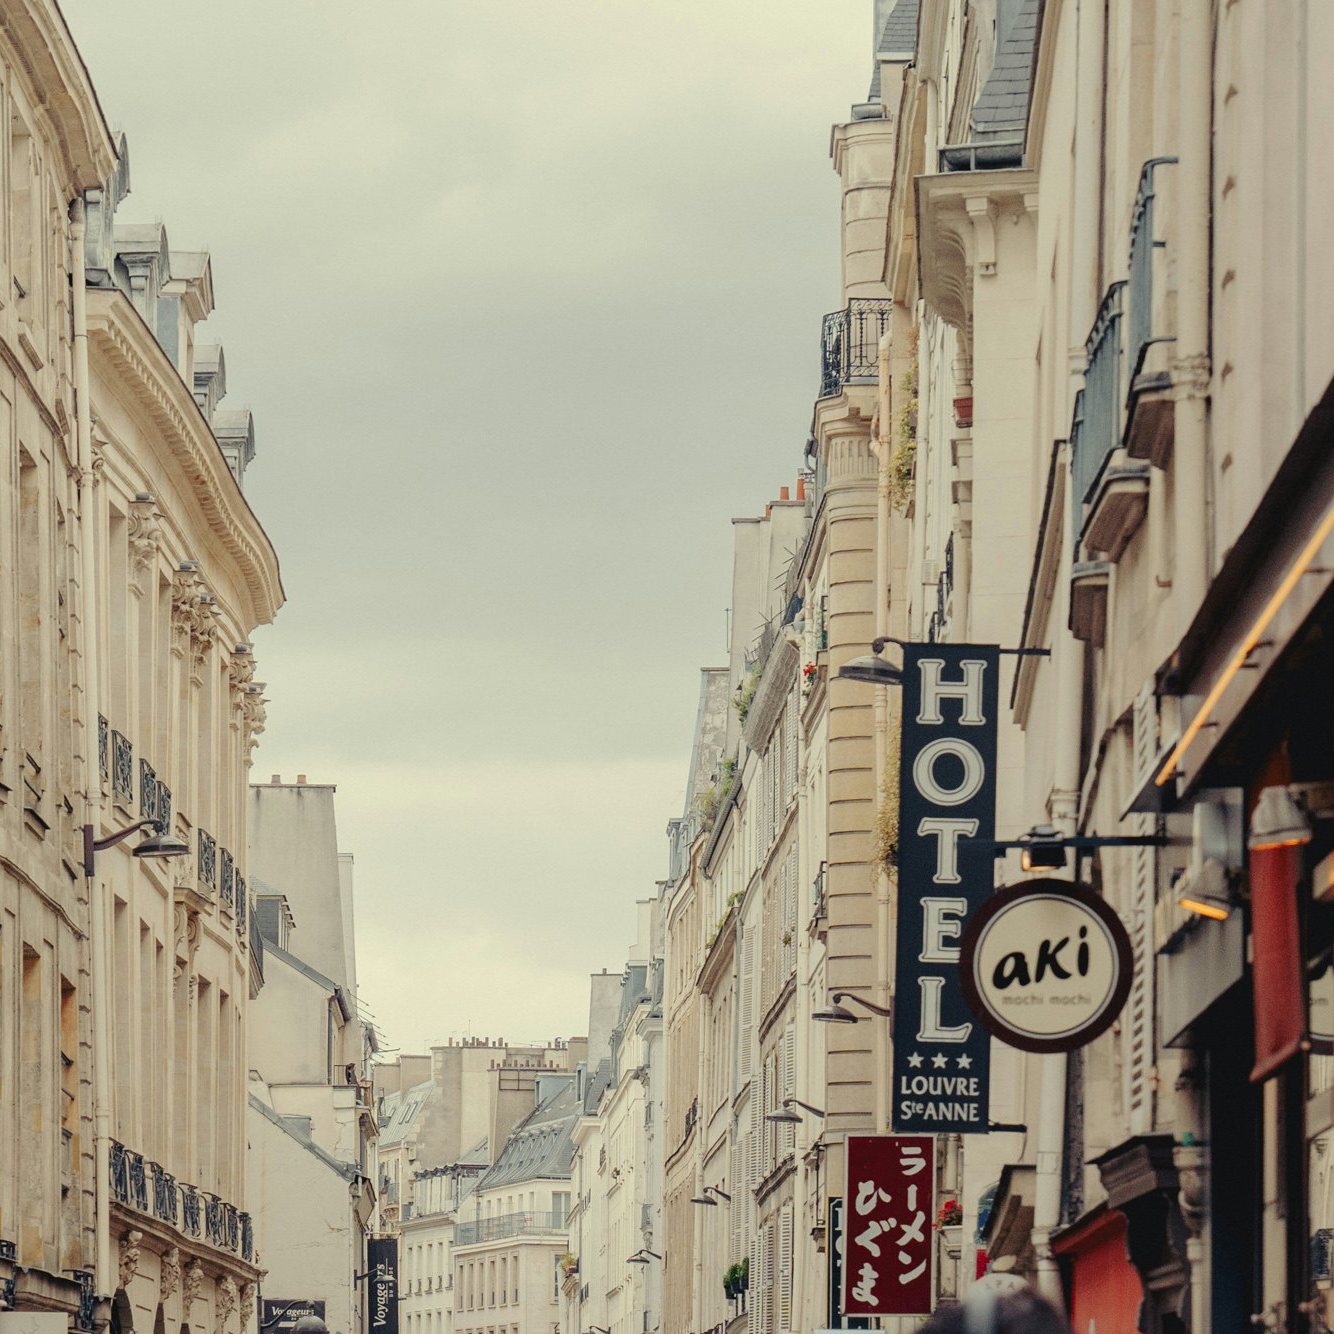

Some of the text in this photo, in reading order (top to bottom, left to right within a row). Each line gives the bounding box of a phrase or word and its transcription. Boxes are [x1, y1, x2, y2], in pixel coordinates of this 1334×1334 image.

[913, 658, 986, 1043] HOTEL
[1002, 994, 1091, 1005] mochi mochi
[900, 1075, 980, 1097] LOUVRE
[851, 1179, 897, 1307] ひぐま
[895, 1146, 927, 1286] ラーメン
